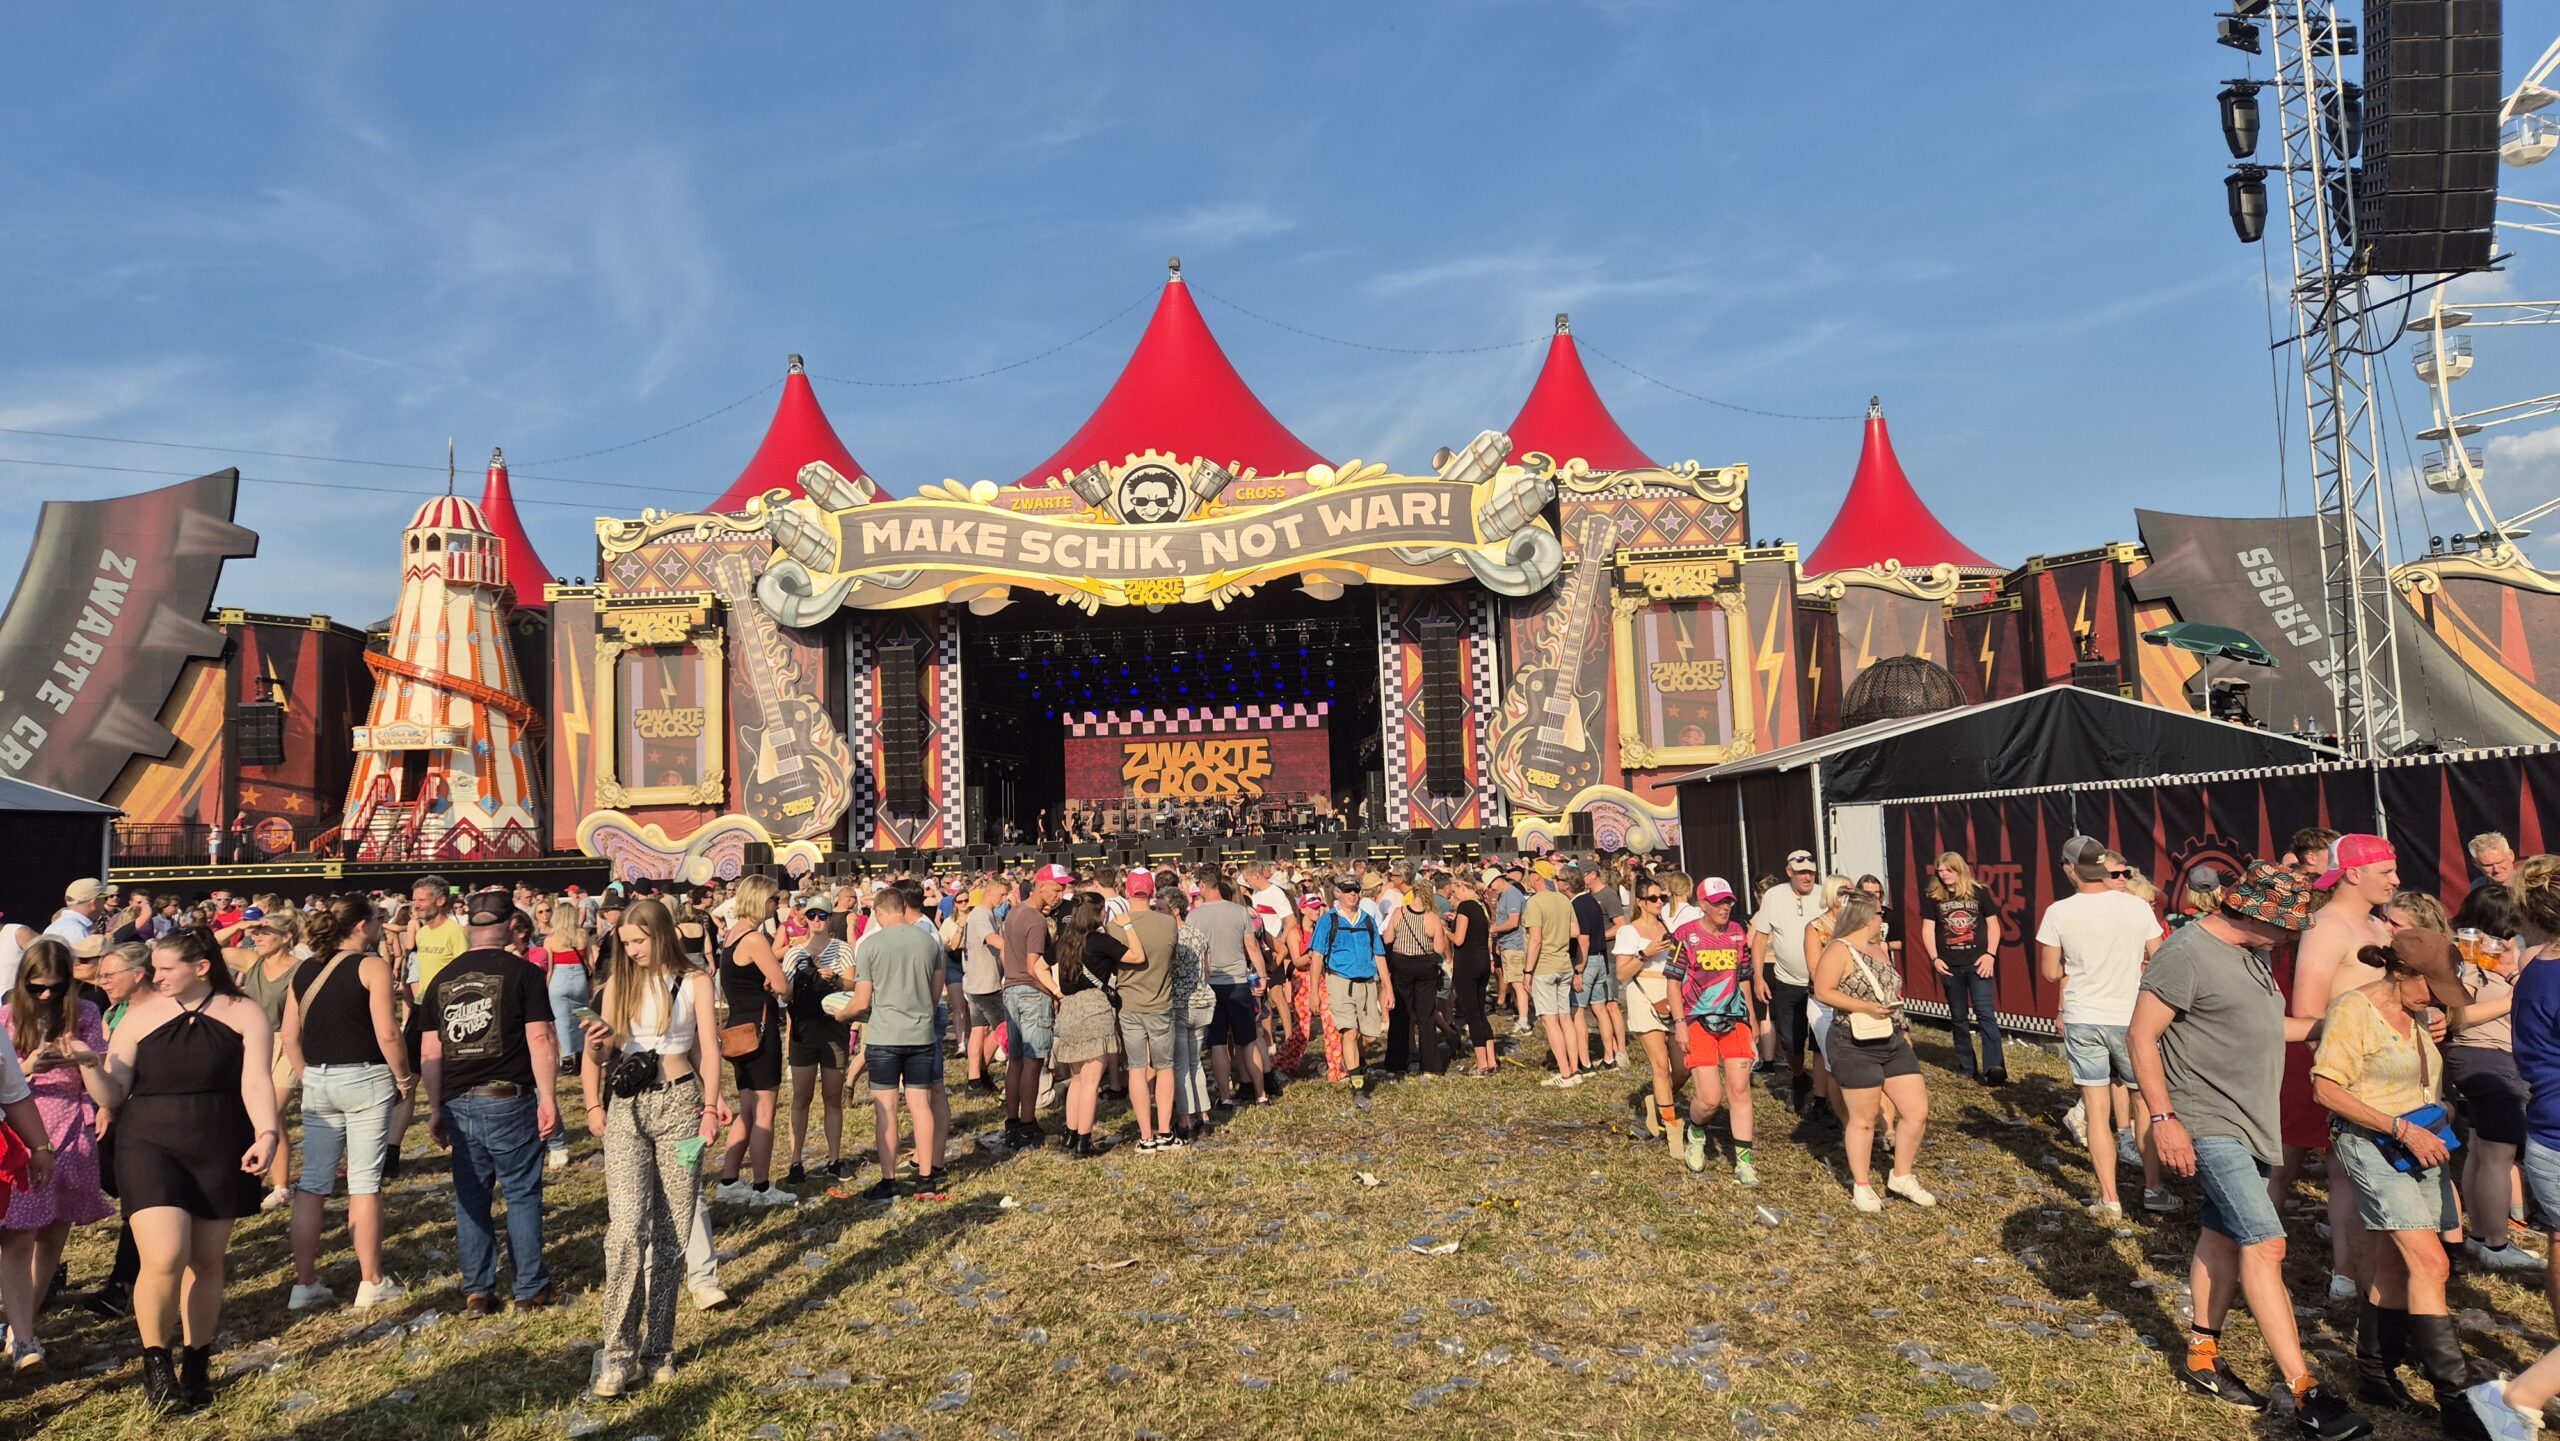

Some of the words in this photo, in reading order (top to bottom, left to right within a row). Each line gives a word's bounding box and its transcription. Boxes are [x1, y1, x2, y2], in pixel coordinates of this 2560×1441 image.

[1011, 496, 1072, 512] ZWARTE
[1235, 486, 1286, 500] CROSS
[861, 518, 1008, 558] MAKE
[1018, 530, 1187, 573] SCHIK,
[1200, 515, 1304, 565] NOT
[1317, 492, 1451, 536] WAR!
[1124, 578, 1185, 595] ZWARTE
[1643, 564, 1719, 587] ZWARTE
[1128, 590, 1182, 606] CROSS
[2237, 547, 2323, 647] CROSS
[35, 549, 137, 715] ZWARTE
[619, 611, 691, 632] ZWARTE
[1651, 660, 1726, 682] ZWARTE
[1657, 674, 1721, 692] CROSS
[635, 707, 705, 729] ZWARTE
[640, 720, 701, 738] CROSS
[0, 715, 48, 777] CR
[1122, 738, 1272, 781] ZWARTE
[1132, 766, 1264, 803] CROSS
[1695, 949, 1738, 964] ZWART
[1701, 958, 1738, 971] CROS
